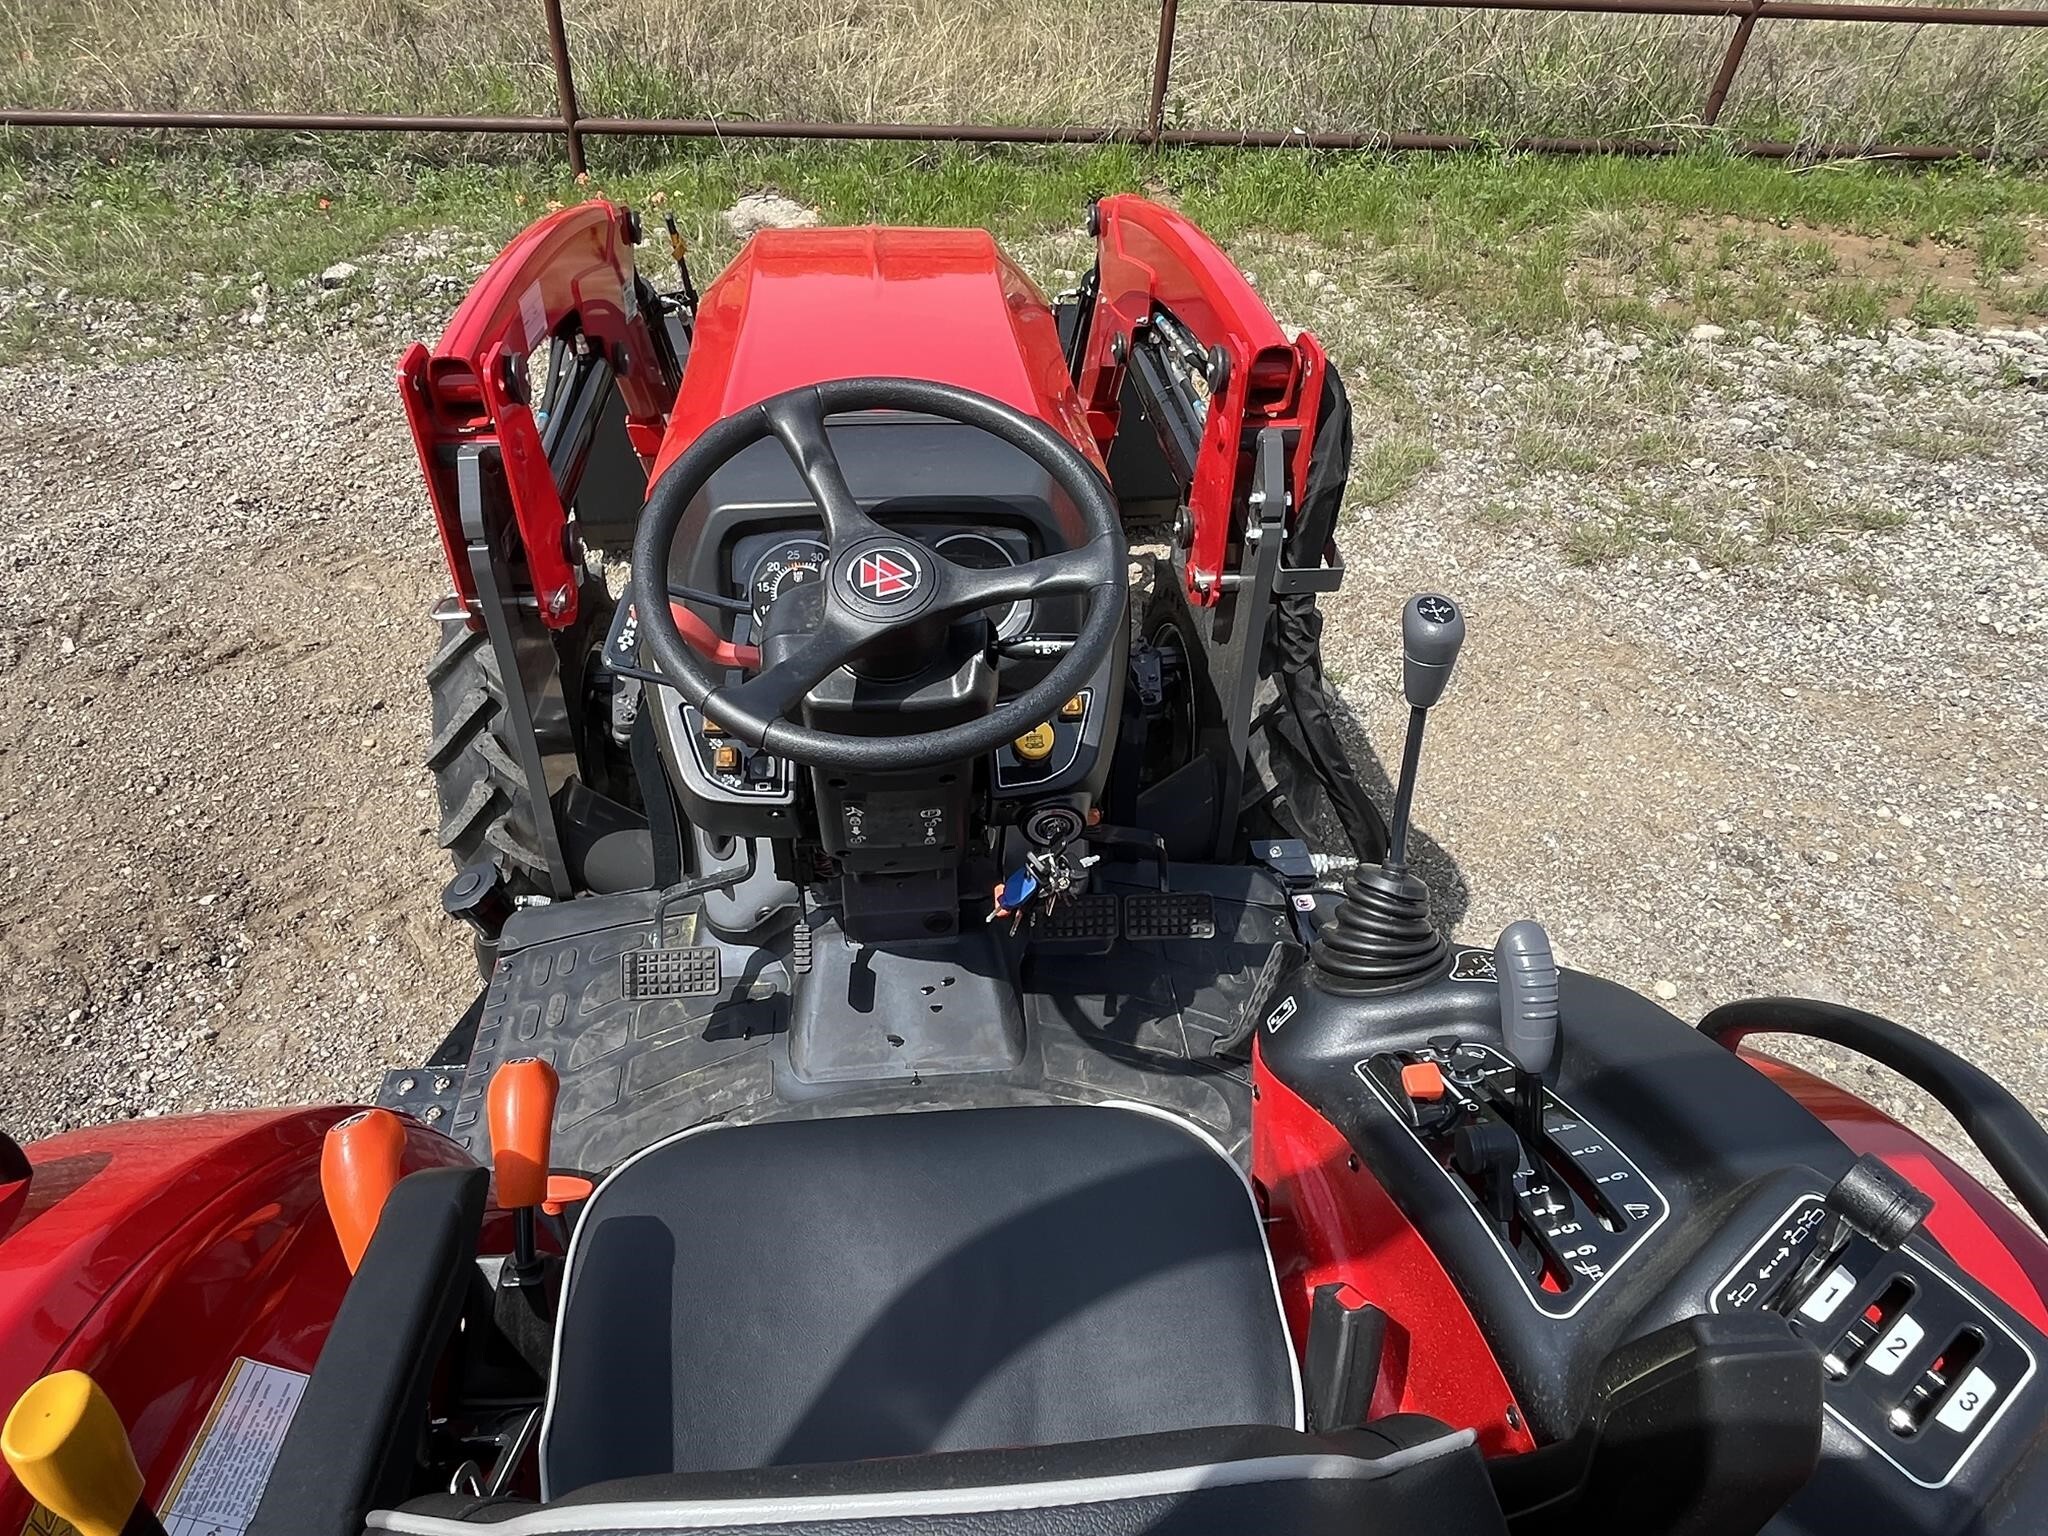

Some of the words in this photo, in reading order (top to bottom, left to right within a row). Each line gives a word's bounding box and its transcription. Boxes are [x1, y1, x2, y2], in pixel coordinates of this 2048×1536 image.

[787, 550, 800, 560] 25
[810, 553, 824, 562] 30
[767, 562, 780, 572] 20
[757, 582, 770, 592] 15
[1561, 1123, 1577, 1131] 4
[1584, 1145, 1603, 1154] 5
[1610, 1171, 1629, 1181] 6
[1531, 1185, 1550, 1194] 3
[1547, 1204, 1565, 1215] 4
[1561, 1223, 1582, 1234] 5
[1577, 1245, 1597, 1256] 6
[1825, 1287, 1839, 1303] 1
[1887, 1338, 1908, 1358] 2
[1959, 1392, 1979, 1411] 3
